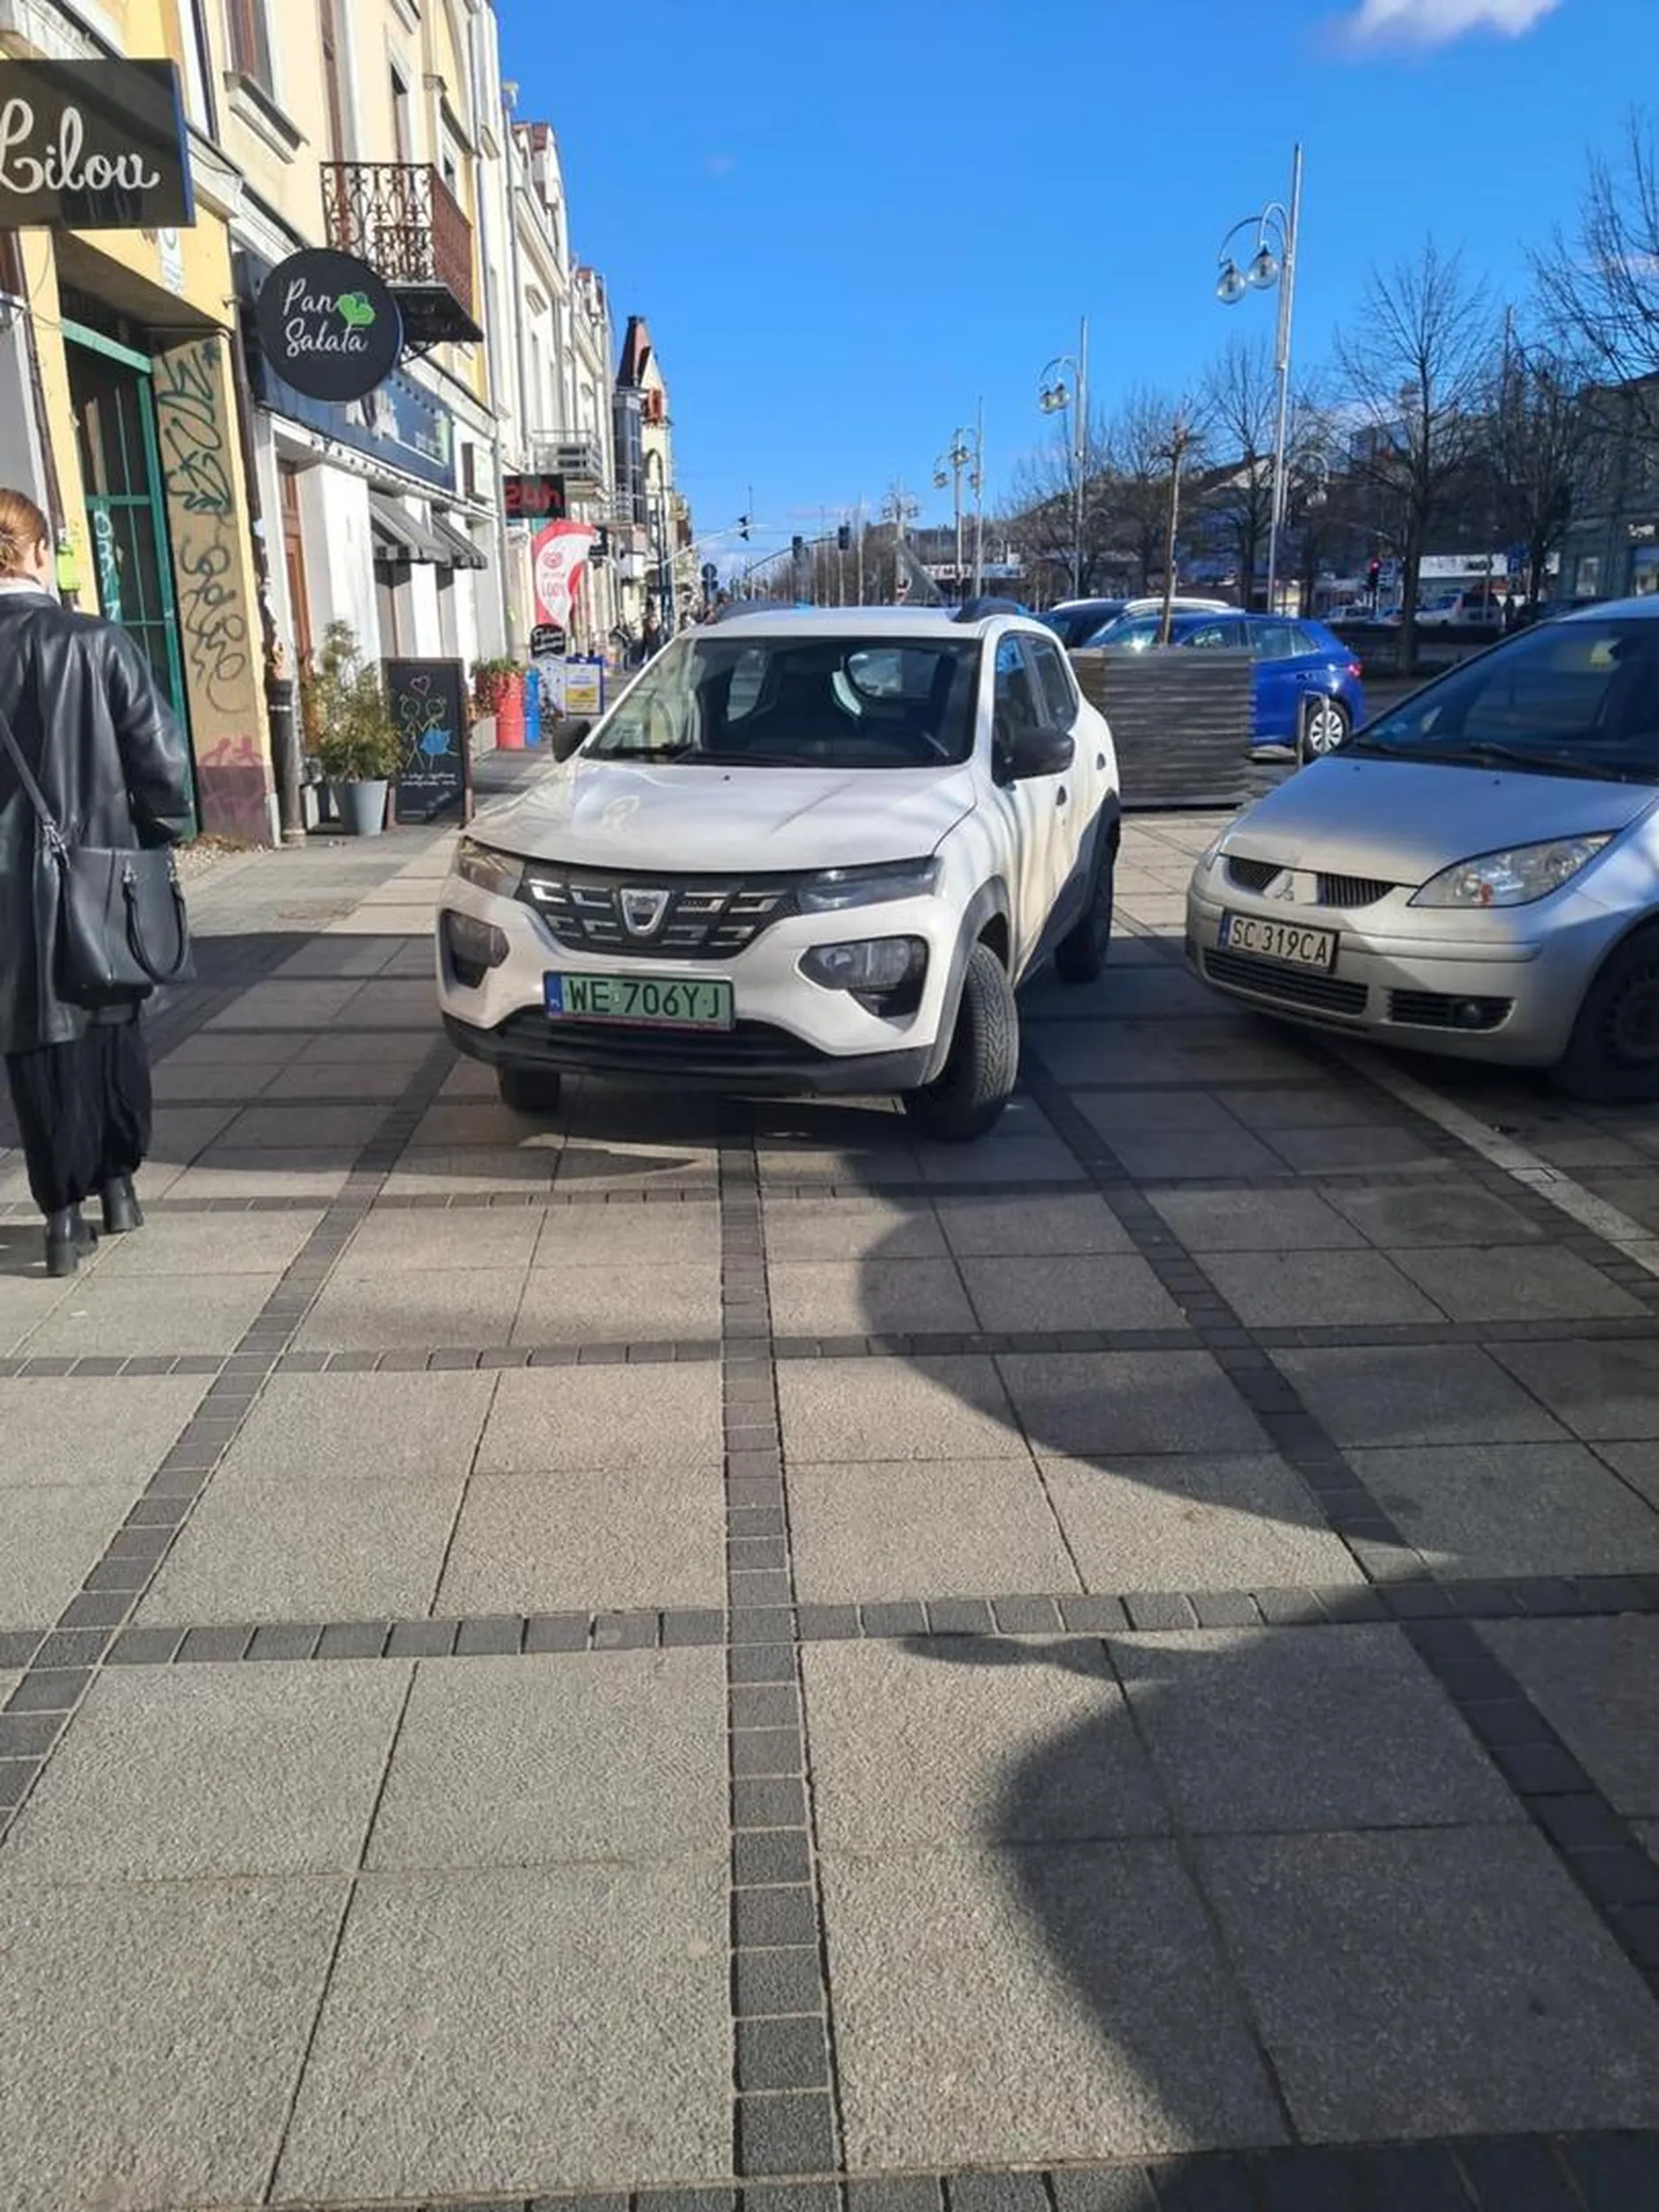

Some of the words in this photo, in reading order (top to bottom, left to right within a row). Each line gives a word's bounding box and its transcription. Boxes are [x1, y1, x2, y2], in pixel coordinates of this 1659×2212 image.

[0, 98, 161, 193] Lilou
[282, 278, 338, 316] Pan
[285, 317, 369, 357] Salata
[504, 483, 561, 510] 24h
[1232, 918, 1256, 948] SC
[1261, 926, 1327, 964] 319CA
[569, 979, 611, 1013] WE
[622, 982, 719, 1018] 706YJ
